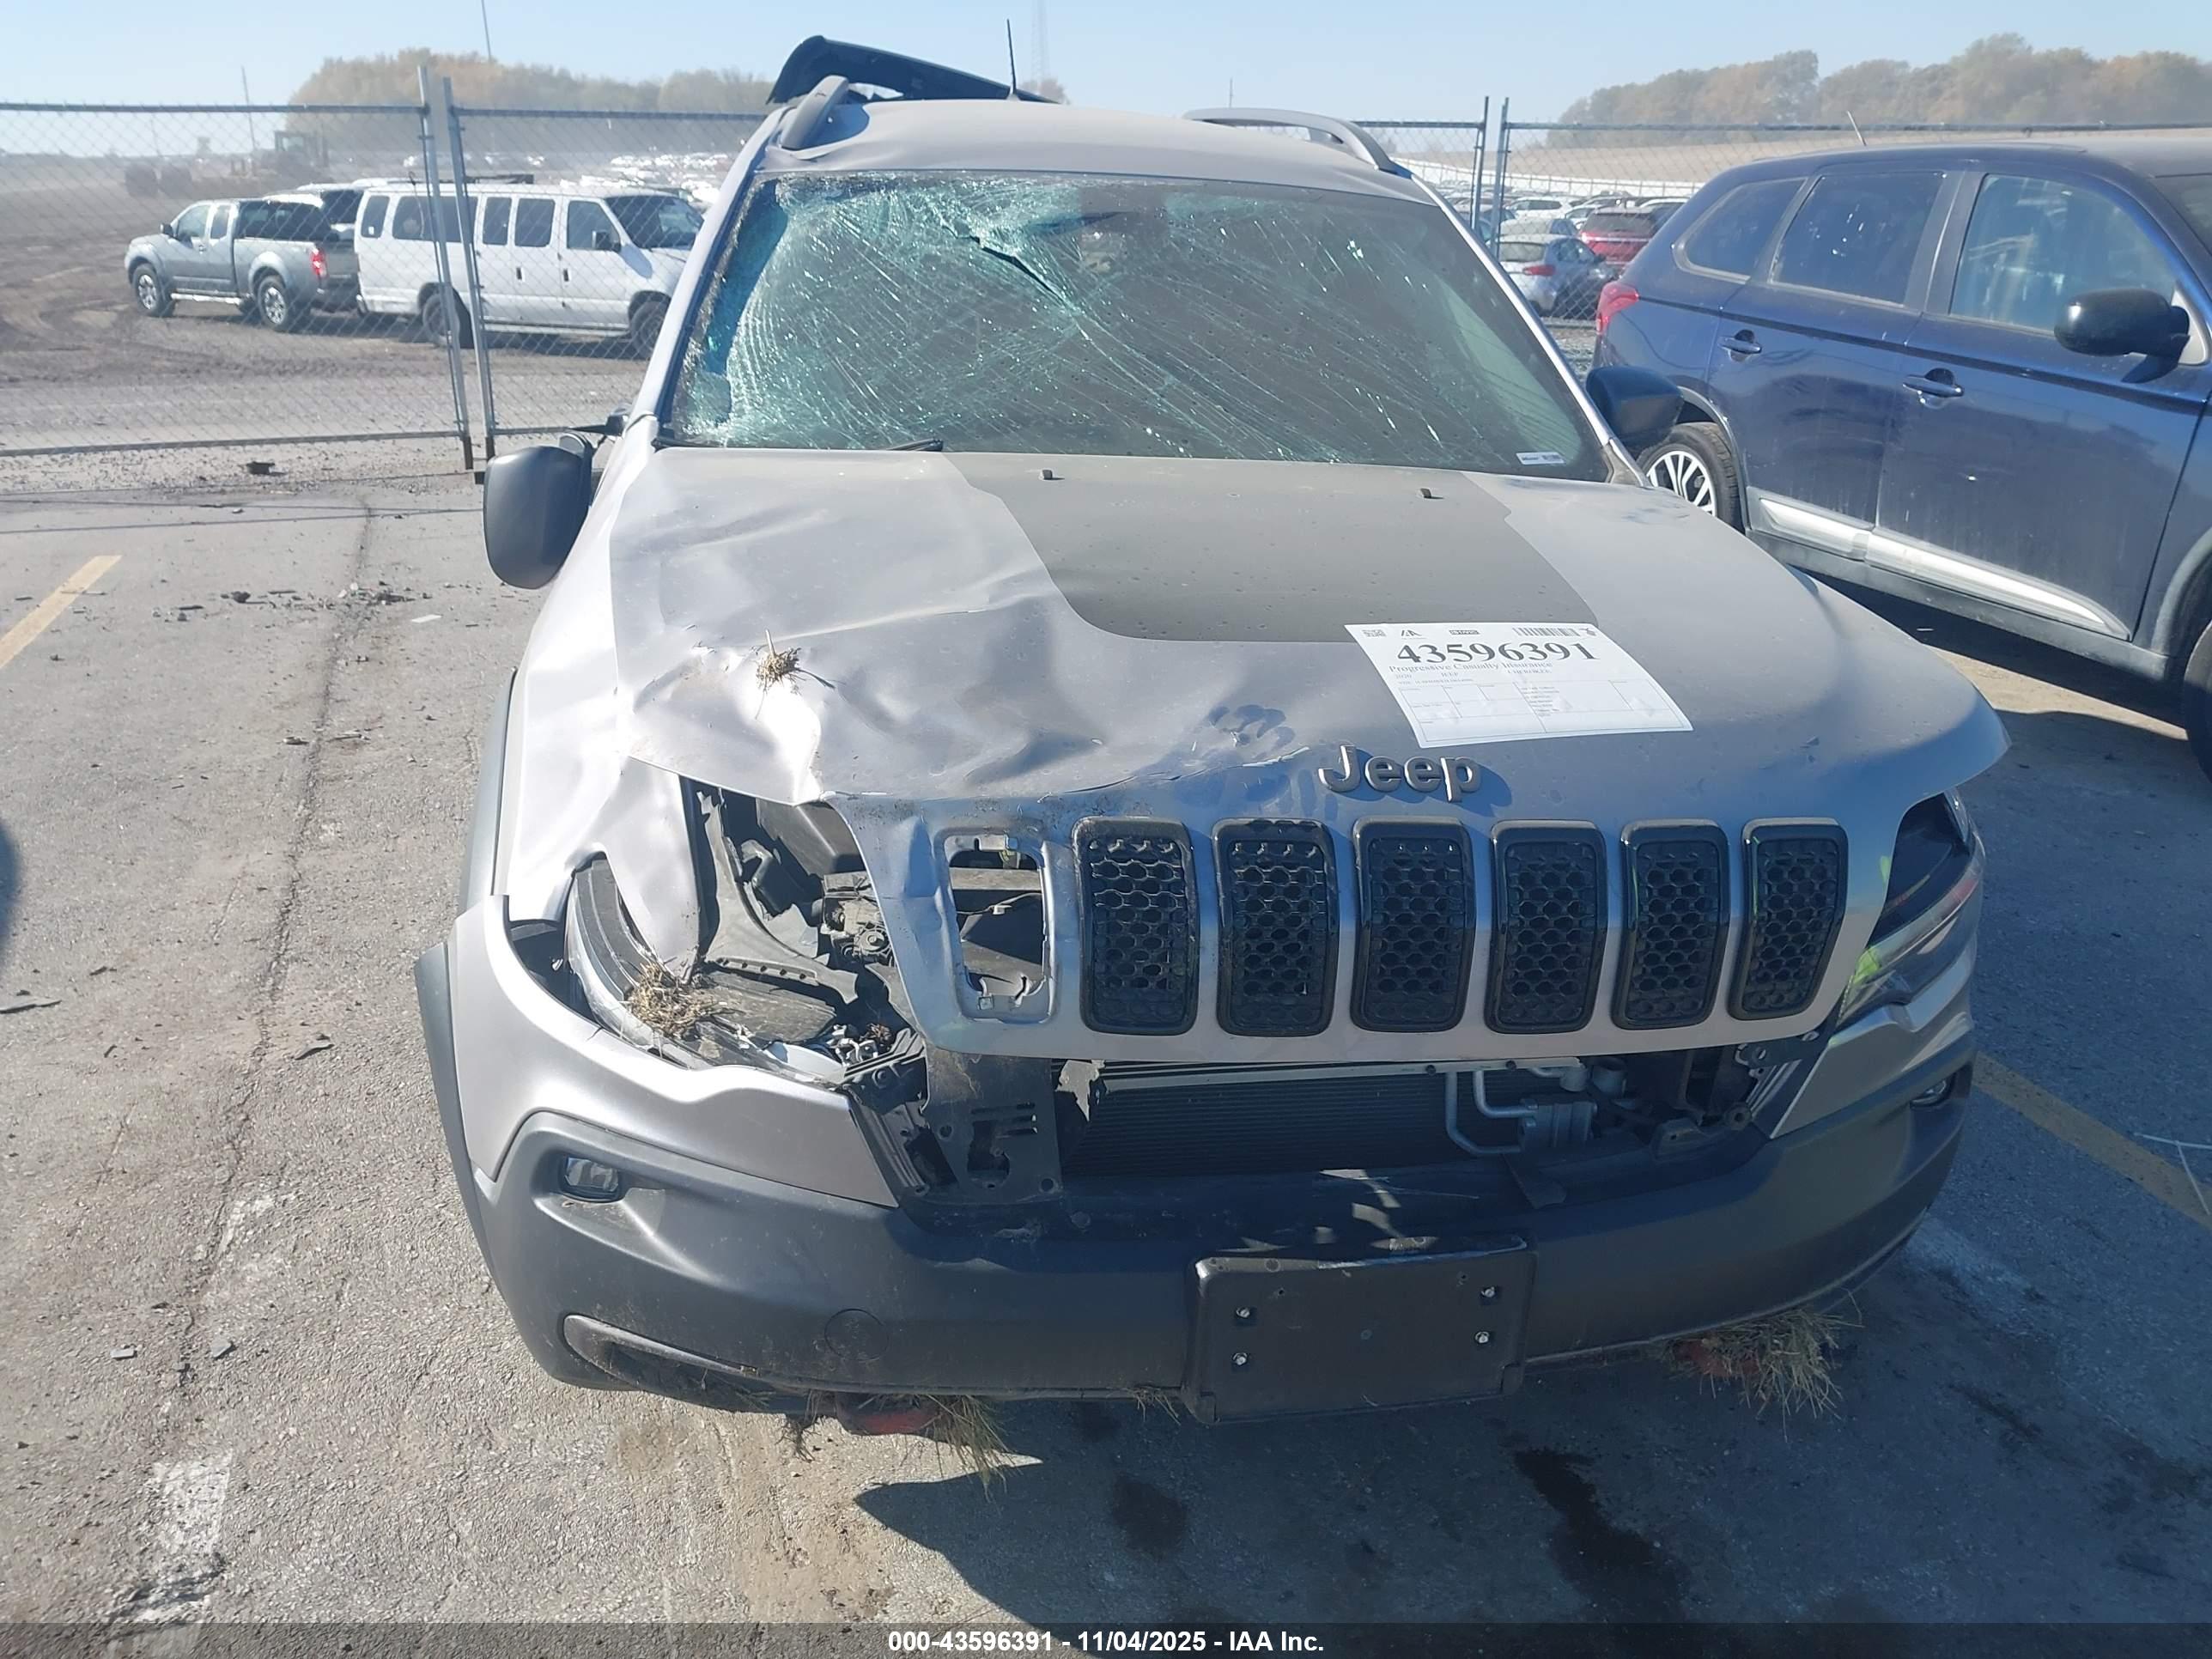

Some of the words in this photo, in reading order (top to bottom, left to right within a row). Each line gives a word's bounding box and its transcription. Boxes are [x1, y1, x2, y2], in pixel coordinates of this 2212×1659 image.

[1397, 642, 1601, 663] 43596391
[1389, 664, 1452, 673] Progressive
[1453, 662, 1499, 671] Casualty
[1318, 744, 1482, 803] Jeep
